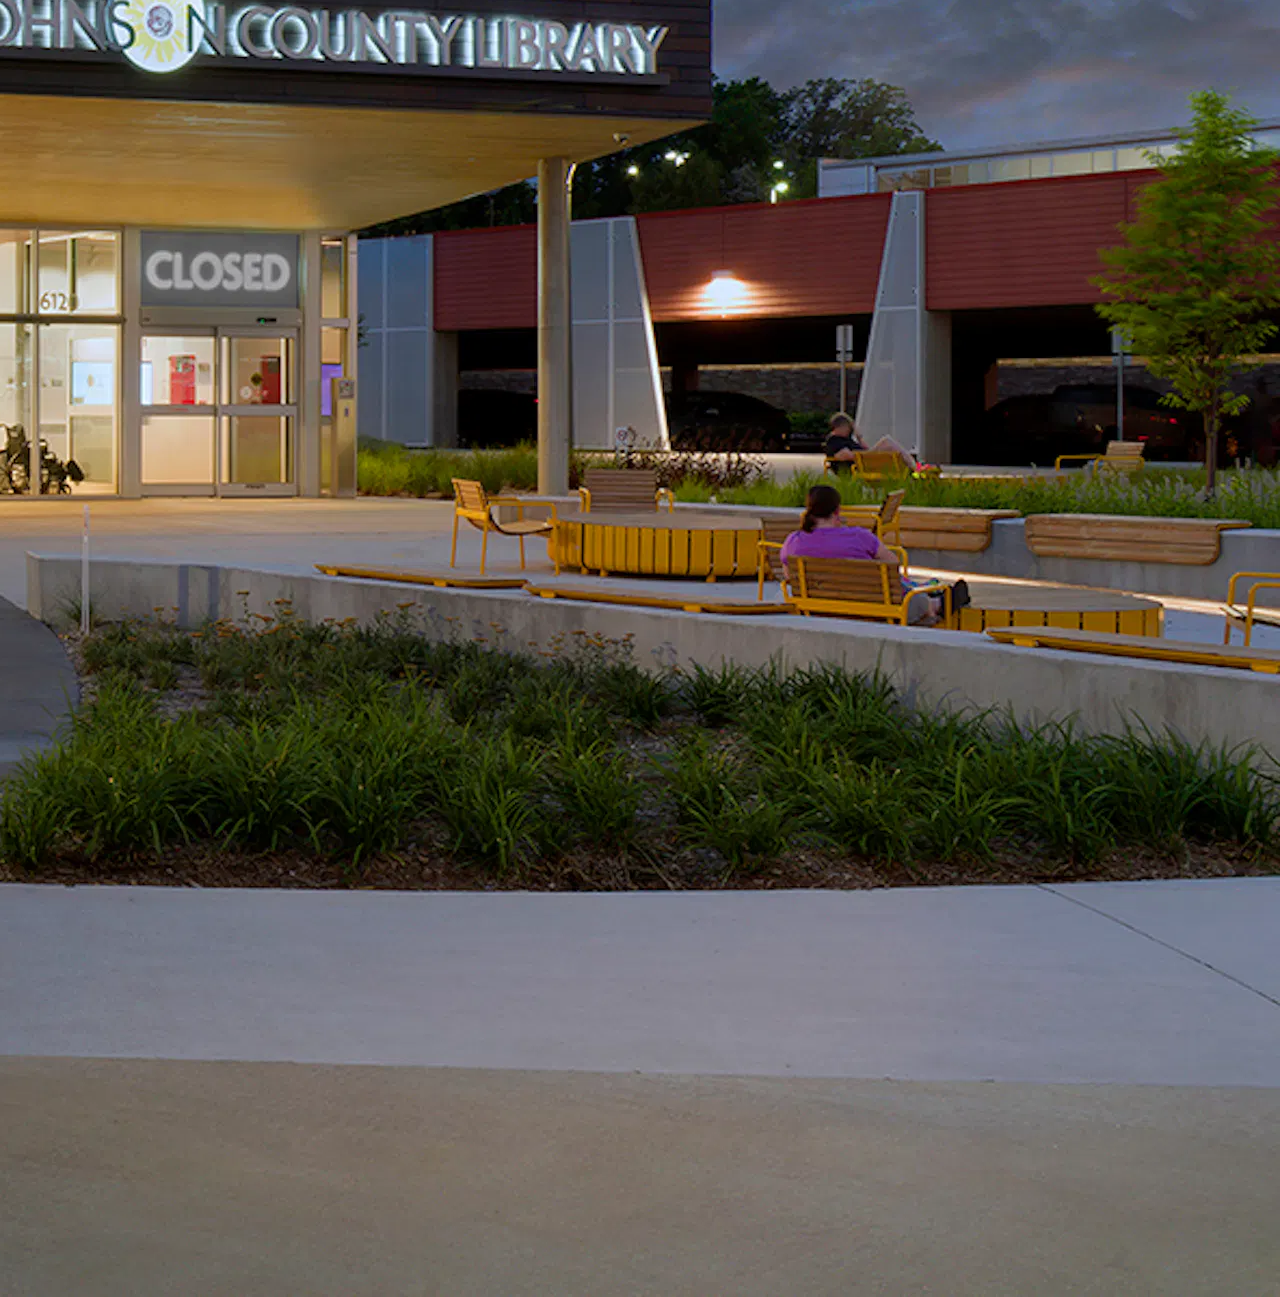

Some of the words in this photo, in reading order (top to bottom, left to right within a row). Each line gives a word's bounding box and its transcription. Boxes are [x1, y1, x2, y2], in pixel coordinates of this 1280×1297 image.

[237, 4, 464, 67] COUNTY
[471, 16, 670, 75] LIBRARY
[145, 249, 291, 292] CLOSED
